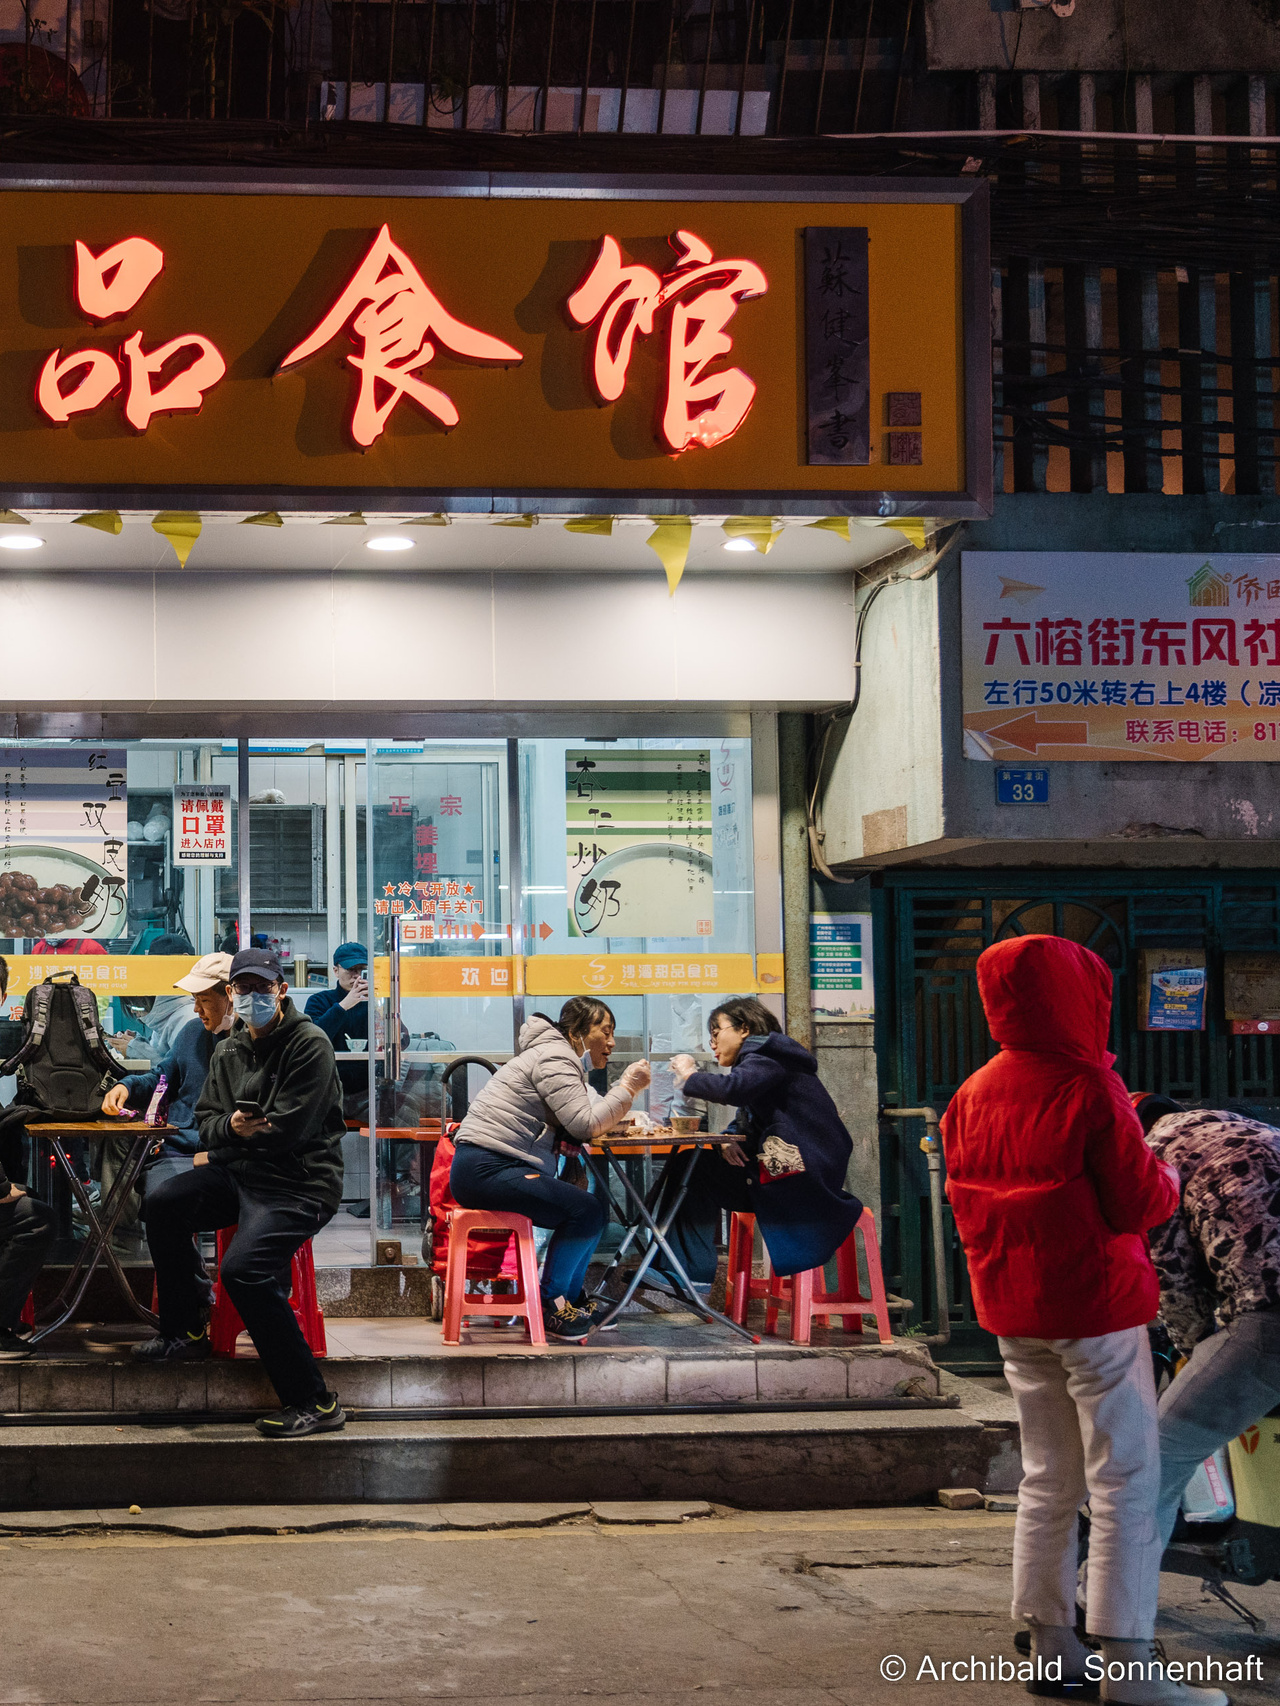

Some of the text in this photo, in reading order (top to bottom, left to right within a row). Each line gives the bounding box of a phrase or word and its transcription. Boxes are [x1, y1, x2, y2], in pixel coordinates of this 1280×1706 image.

[1012, 783, 1034, 801] 33
[181, 799, 224, 813] 请佩戴
[183, 815, 225, 836] 口罩
[78, 753, 127, 933] 红豆双皮奶
[181, 838, 224, 848] 进入店内
[569, 756, 621, 933] 杏仁炒奶
[398, 881, 460, 896] 冷气开放
[375, 900, 484, 915] 请出入随手关门
[403, 925, 434, 939] 右推
[622, 964, 718, 979] 沙湾甜品食馆
